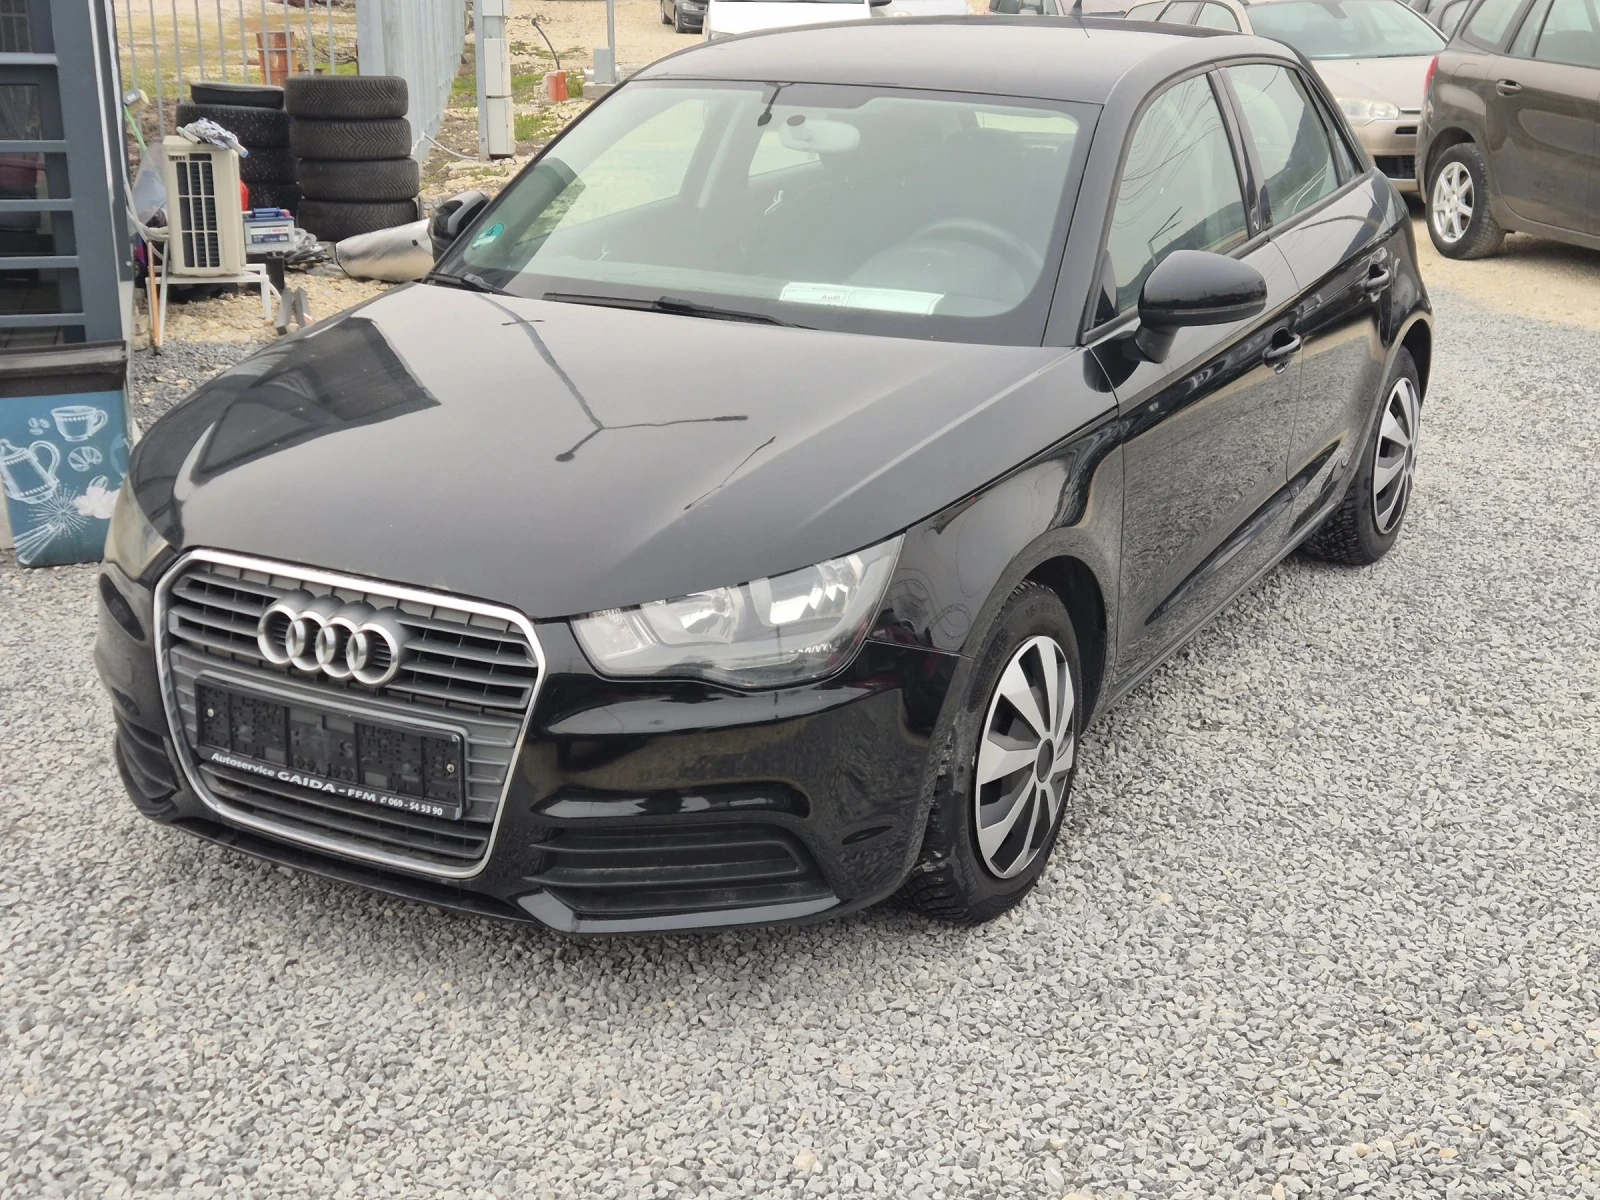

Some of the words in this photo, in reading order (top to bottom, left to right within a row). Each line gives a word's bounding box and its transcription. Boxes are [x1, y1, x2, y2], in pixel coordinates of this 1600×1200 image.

[211, 752, 275, 777] Autoservice
[277, 771, 336, 794] GAIDA
[347, 788, 376, 802] FFM
[388, 797, 403, 808] 069
[409, 801, 420, 811] 54
[421, 804, 431, 814] 53
[432, 806, 443, 816] 90
